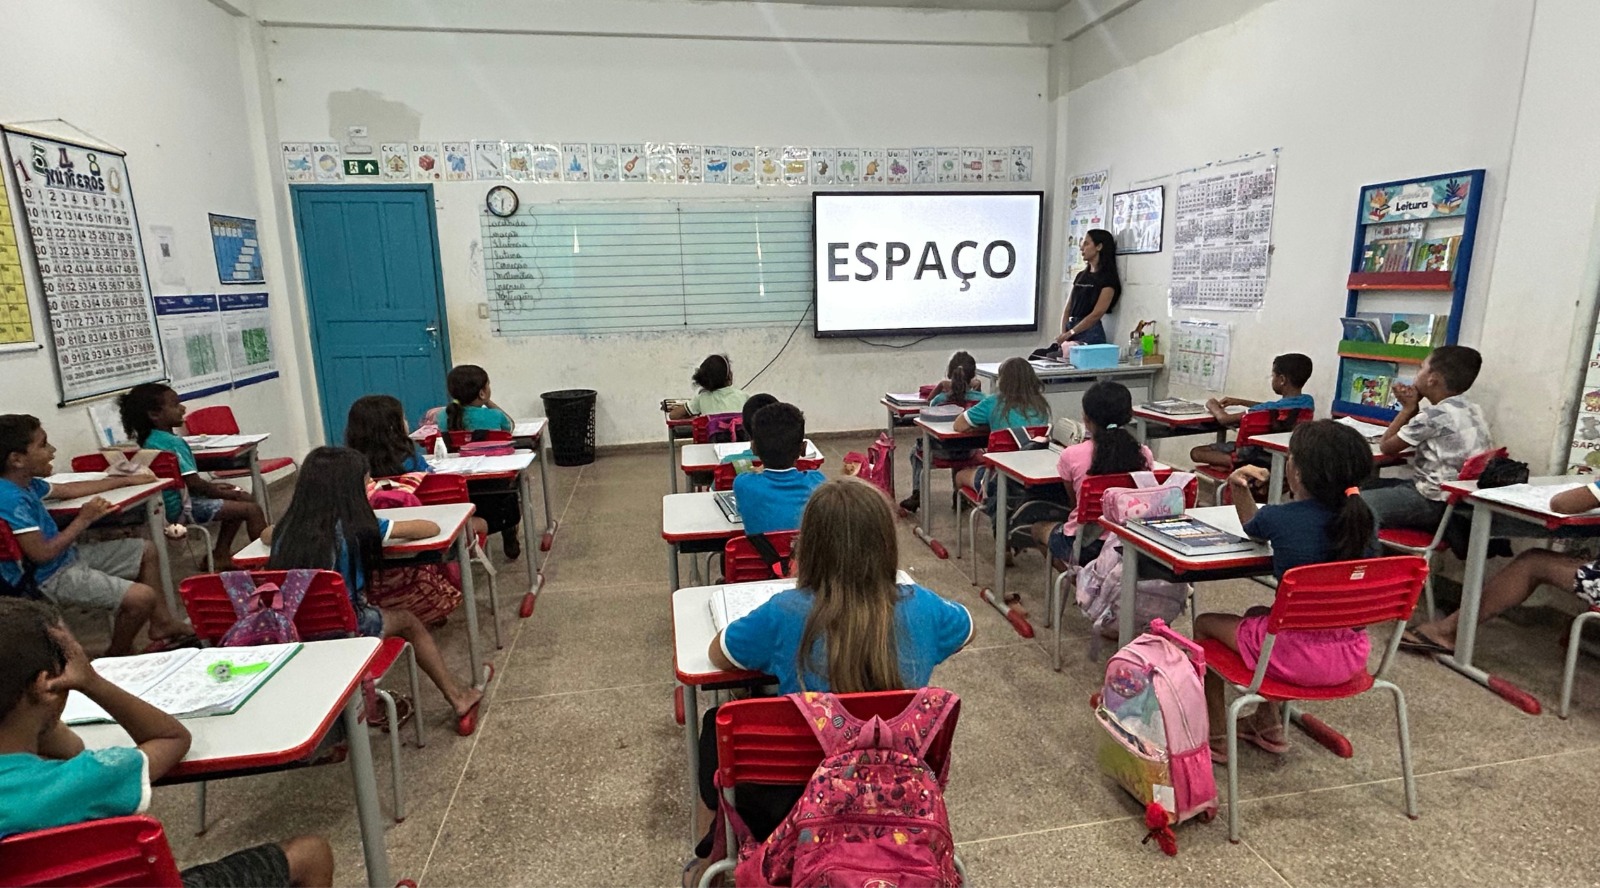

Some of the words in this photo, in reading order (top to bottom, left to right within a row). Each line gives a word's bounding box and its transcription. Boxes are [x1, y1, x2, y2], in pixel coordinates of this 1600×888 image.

[32, 142, 48, 176] 5
[87, 153, 100, 176] 8
[15, 158, 31, 182] 1
[44, 168, 105, 192] NÚMEROS
[108, 168, 121, 194] 0
[25, 188, 32, 198] 0
[38, 190, 42, 199] 1
[50, 192, 56, 201] 2
[61, 193, 67, 202] 3
[72, 194, 77, 204] 4
[83, 196, 88, 204] 5
[93, 197, 98, 206] 6
[102, 198, 106, 206] 7
[1396, 201, 1428, 211] Leitura
[28, 208, 38, 217] 10
[42, 210, 48, 218] 11
[51, 210, 62, 220] 12
[64, 211, 72, 220] 13
[74, 212, 82, 221] 14
[84, 213, 93, 222] 15
[95, 214, 103, 223] 16
[104, 216, 111, 224] 17
[114, 216, 122, 225] 18
[32, 227, 42, 236] 20
[46, 228, 52, 237] 21
[54, 228, 65, 238] 22
[68, 229, 76, 238] 23
[88, 230, 97, 239] 25
[98, 231, 107, 240] 26
[36, 246, 46, 255] 30
[50, 247, 57, 255] 31
[59, 247, 69, 256] 32
[72, 247, 80, 256] 33
[92, 248, 100, 257] 35
[102, 248, 110, 257] 36
[54, 265, 60, 274] 41
[62, 264, 72, 274] 42
[75, 265, 84, 273] 43
[85, 264, 93, 273] 44
[96, 265, 104, 274] 45
[105, 265, 113, 274] 46
[114, 265, 122, 274] 47
[124, 265, 132, 274] 48
[827, 240, 1016, 292] ESPAÇO
[44, 282, 54, 292] 50
[58, 283, 65, 292] 51
[66, 282, 76, 292] 52
[79, 282, 87, 291] 53
[89, 282, 97, 290] 54
[98, 282, 108, 290] 55
[109, 282, 116, 290] 56
[117, 281, 125, 290] 57
[127, 281, 135, 290] 58
[61, 301, 69, 310] 61
[70, 300, 80, 309] 62
[82, 299, 91, 308] 63
[102, 298, 111, 307] 65
[64, 318, 72, 327] 71
[74, 317, 83, 326] 72
[85, 316, 95, 325] 73
[105, 315, 115, 323] 75
[124, 314, 131, 322] 77
[69, 336, 77, 345] 81
[89, 333, 98, 342] 83
[109, 331, 118, 340] 85
[72, 353, 81, 363] 91
[92, 350, 102, 360] 93
[112, 347, 121, 356] 95
[129, 345, 137, 353] 97
